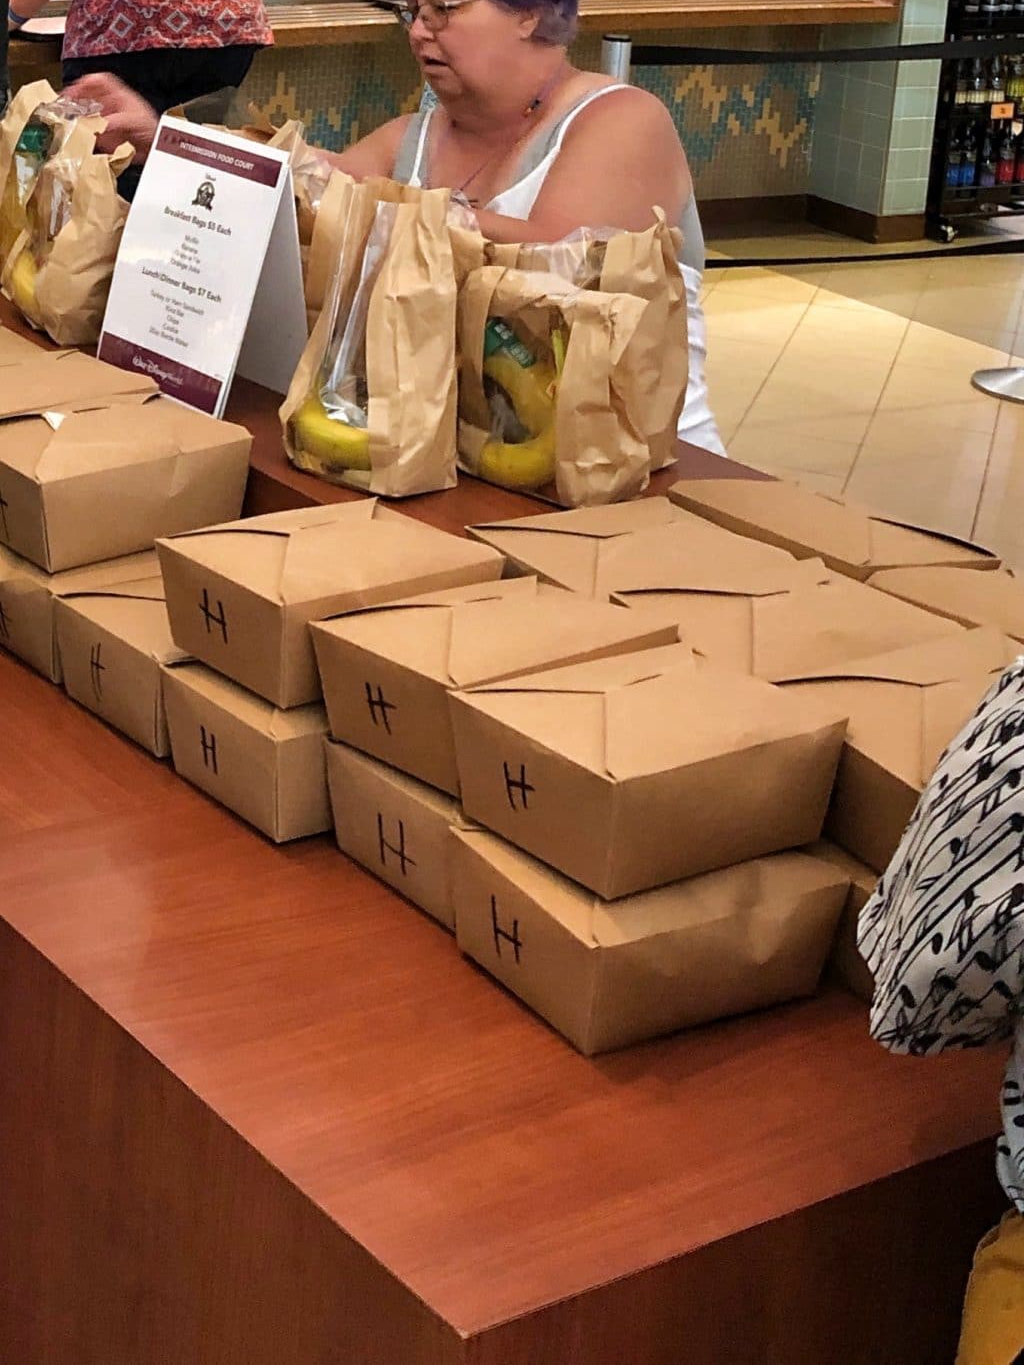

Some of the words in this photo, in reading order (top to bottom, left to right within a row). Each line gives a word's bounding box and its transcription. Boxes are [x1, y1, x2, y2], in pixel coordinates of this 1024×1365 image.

[179, 141, 217, 159] INTERMISSION
[217, 152, 234, 164] FOOD
[234, 159, 254, 170] COURT
[164, 206, 191, 222] Breakfast
[191, 213, 207, 228] Bags
[216, 224, 232, 235] Each
[181, 281, 197, 294] Bags
[197, 287, 207, 296] $7
[207, 291, 222, 303] Each
[199, 588, 228, 644] H
[365, 681, 397, 735] H
[200, 725, 218, 775] H
[504, 761, 535, 810] H
[378, 812, 416, 876] H
[491, 894, 522, 974] H
